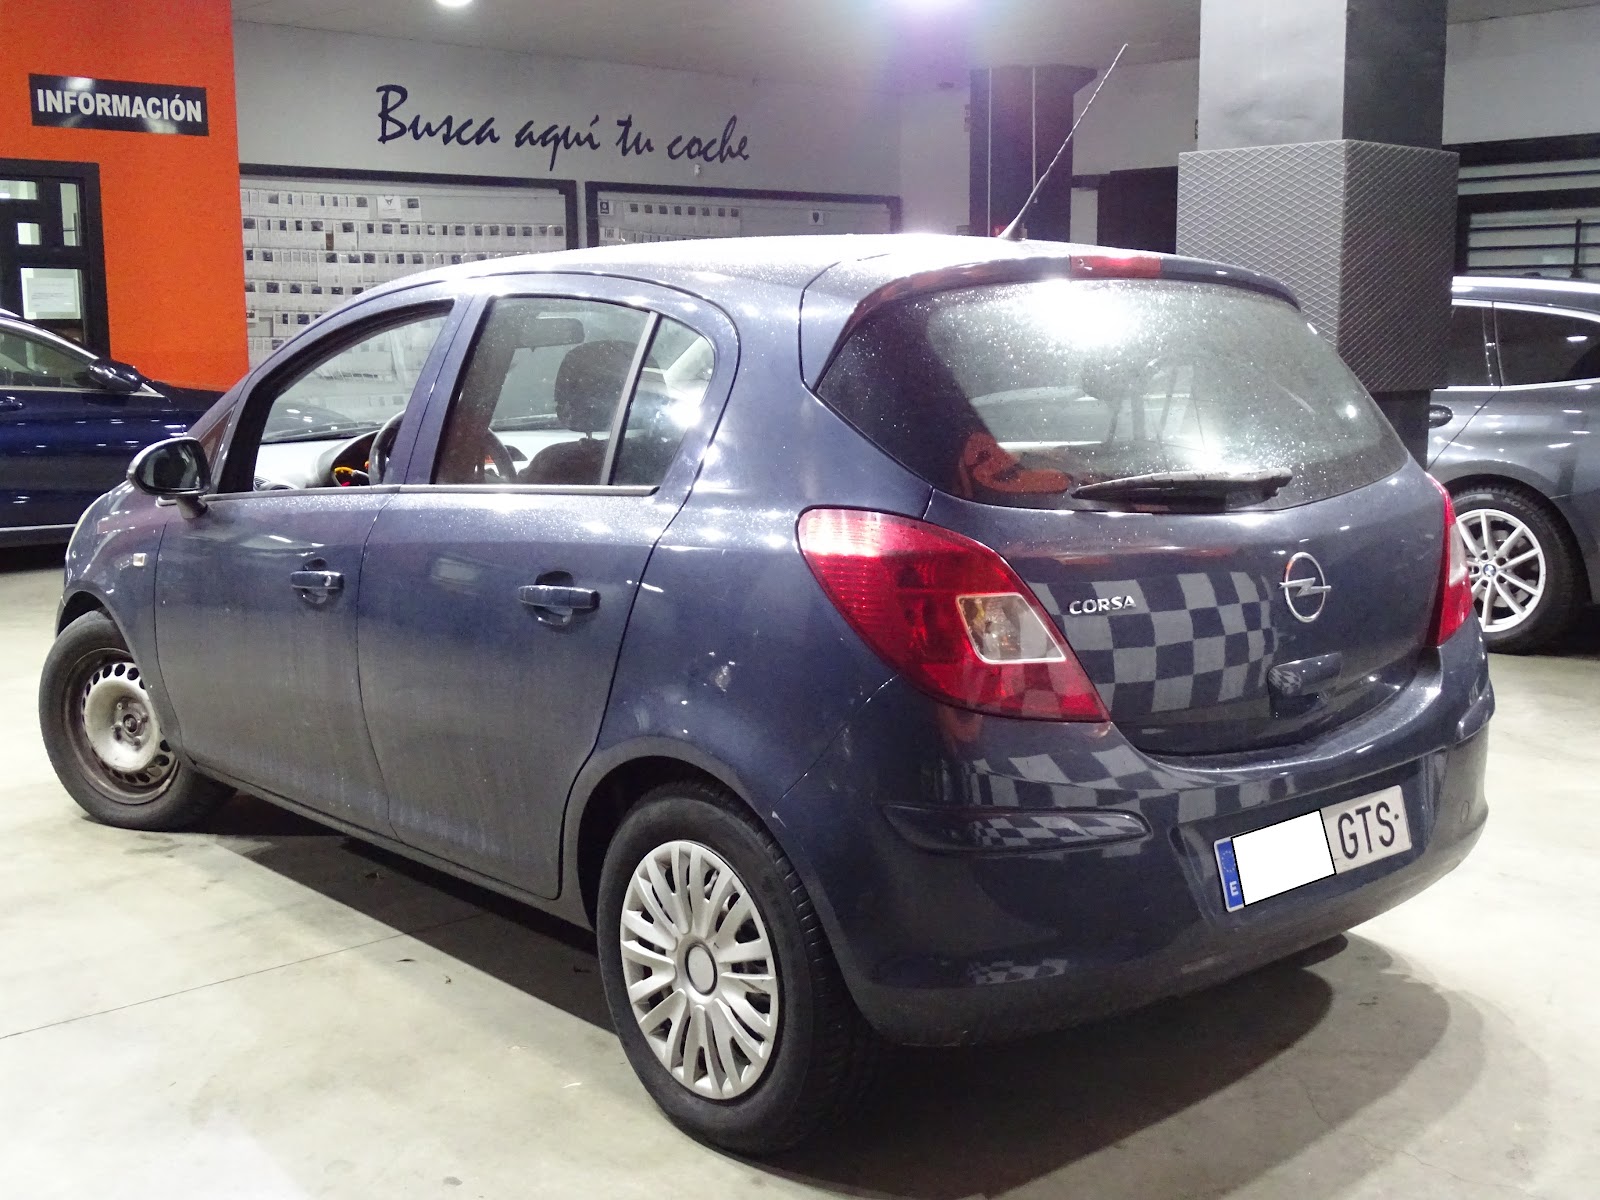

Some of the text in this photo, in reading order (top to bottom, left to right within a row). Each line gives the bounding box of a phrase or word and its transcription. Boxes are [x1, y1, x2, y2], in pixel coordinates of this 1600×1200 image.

[37, 88, 203, 123] INFORMACIÓN
[376, 84, 750, 172] Busca aquí tu coche
[1069, 595, 1137, 615] CORSA
[1337, 800, 1396, 860] GTS
[1229, 880, 1239, 897] E
